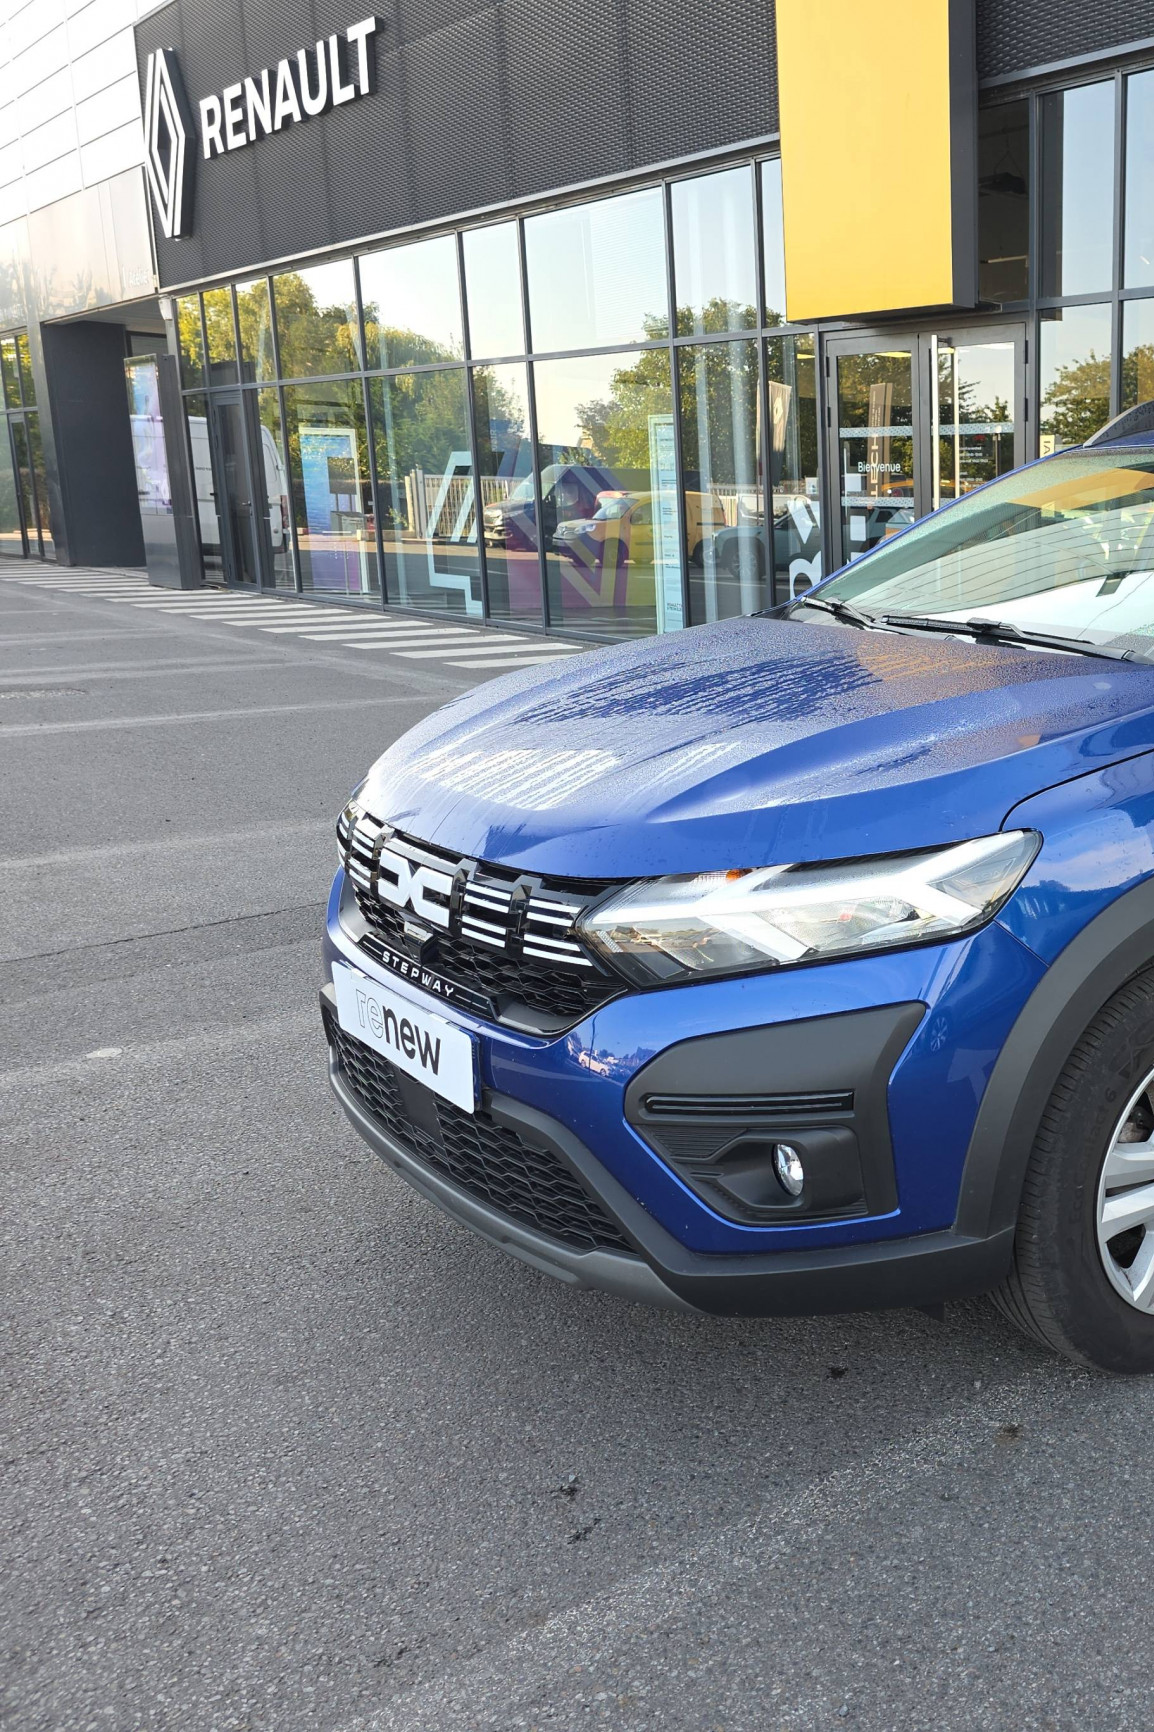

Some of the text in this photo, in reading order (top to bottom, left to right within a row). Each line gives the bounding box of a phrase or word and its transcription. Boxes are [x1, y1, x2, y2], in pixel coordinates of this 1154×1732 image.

[199, 16, 376, 160] RENAULT
[382, 951, 454, 997] STEPWAY
[355, 988, 441, 1076] renew
